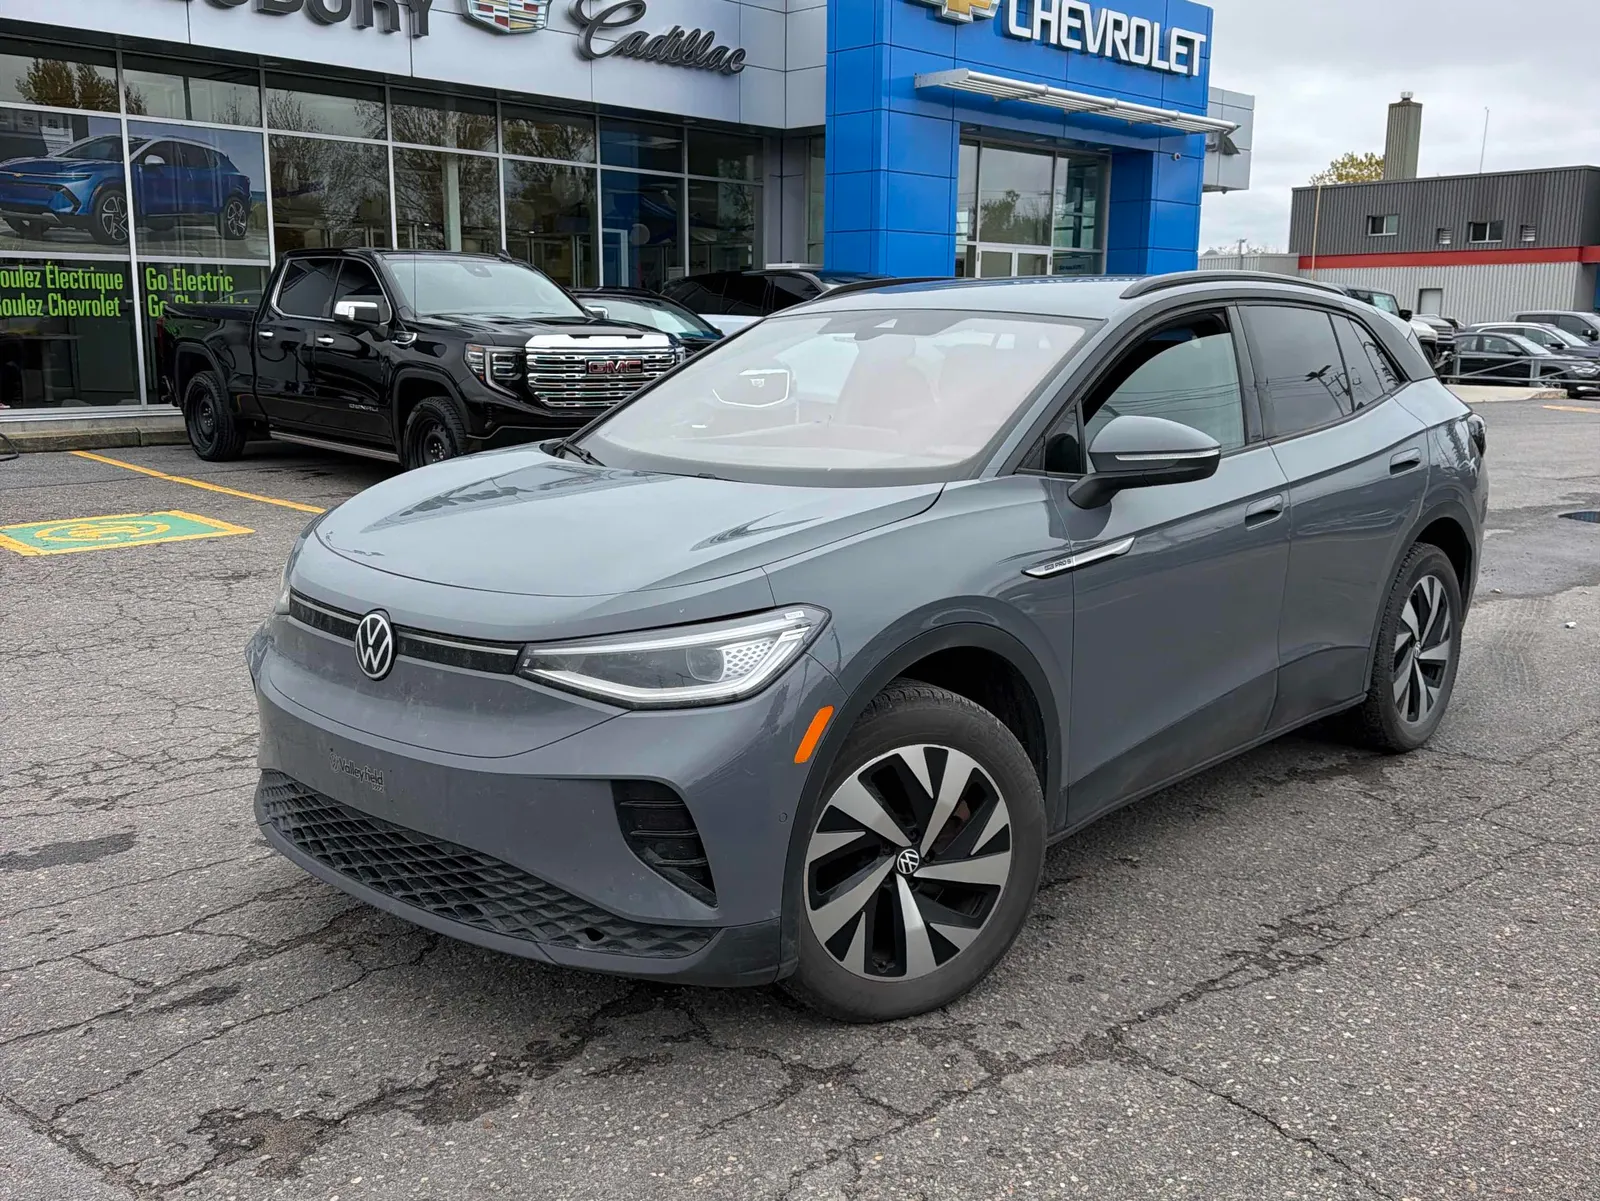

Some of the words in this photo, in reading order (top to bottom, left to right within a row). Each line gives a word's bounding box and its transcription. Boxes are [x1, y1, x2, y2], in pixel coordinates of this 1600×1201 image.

[568, 0, 747, 74] Cadillac
[1003, 0, 1207, 77] CHEVROLET
[0, 264, 42, 289] oulez
[45, 261, 124, 294] Électrique
[145, 267, 168, 291] Go
[172, 269, 234, 292] Electric
[0, 292, 44, 317] oulez
[47, 292, 121, 317] Chevrolet
[588, 360, 642, 373] GMC
[337, 756, 385, 786] Valleyfield
